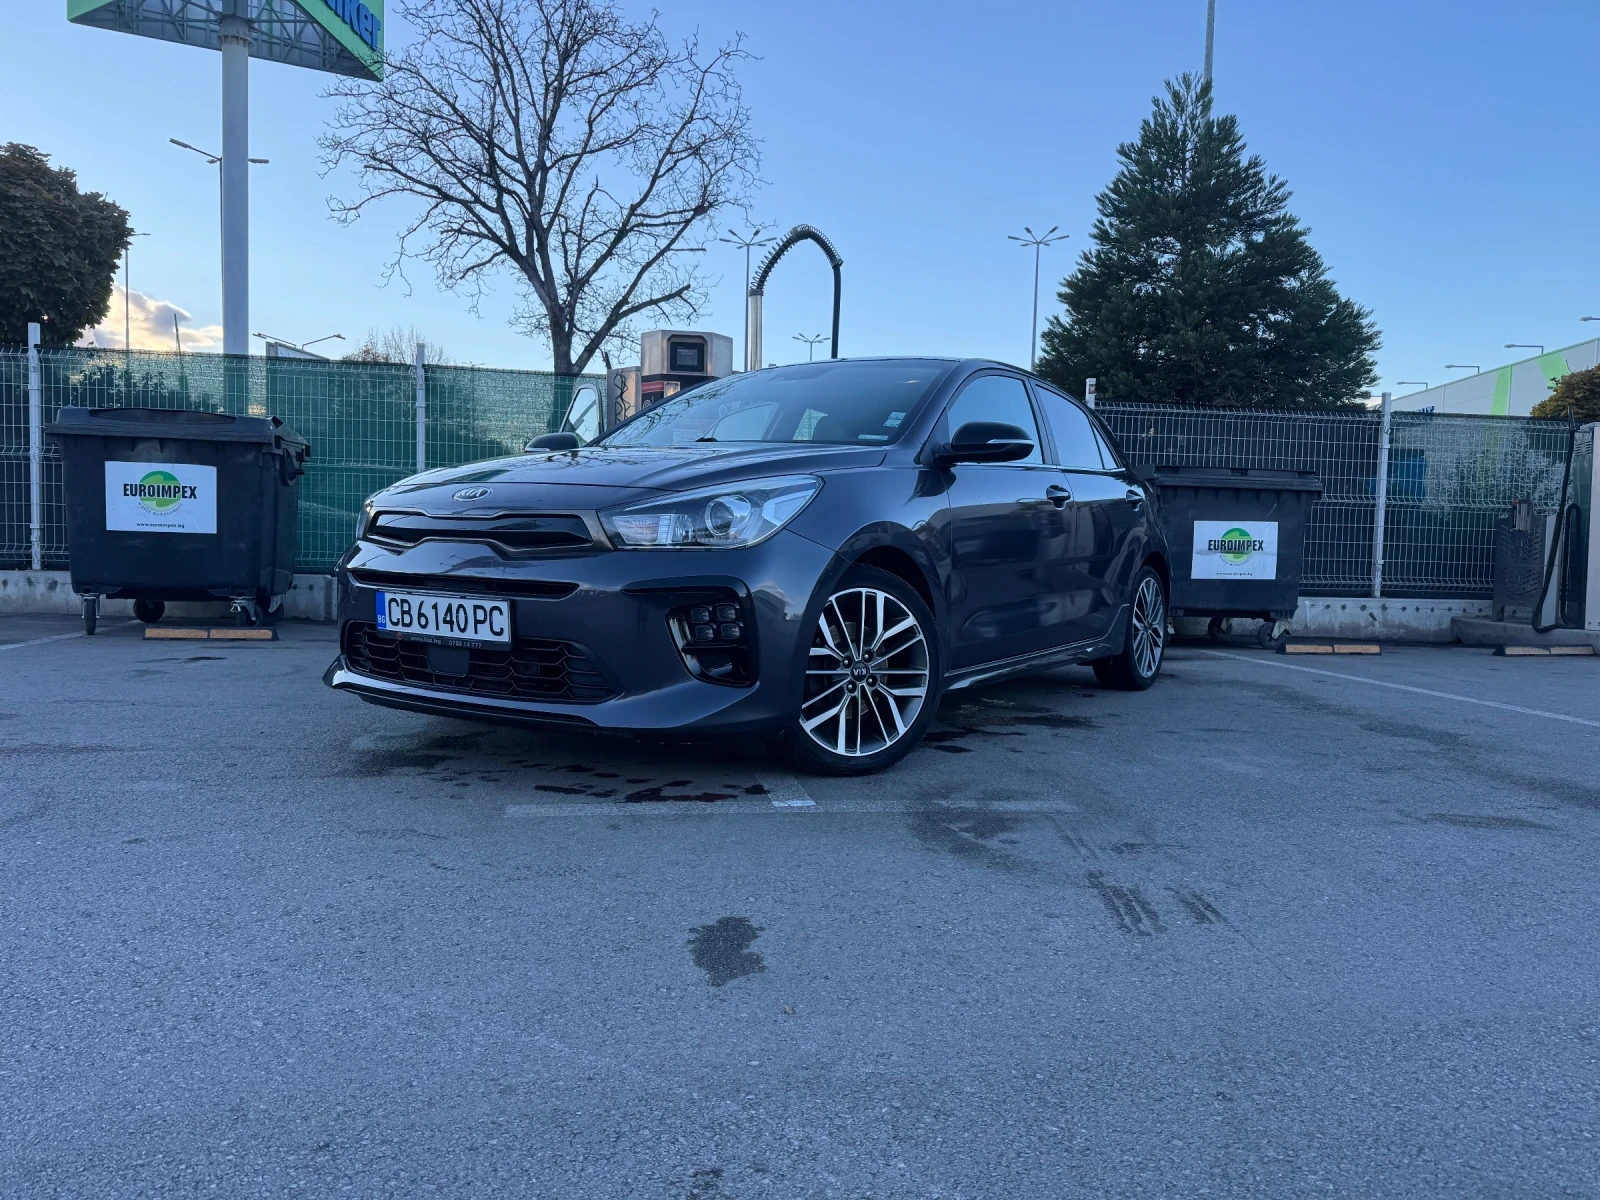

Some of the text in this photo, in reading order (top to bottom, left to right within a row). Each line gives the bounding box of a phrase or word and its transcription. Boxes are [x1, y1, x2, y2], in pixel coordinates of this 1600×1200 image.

[123, 483, 198, 500] EUROIMPEX
[455, 487, 484, 497] KIA
[1207, 539, 1264, 552] EUROIMPEX
[377, 614, 386, 624] BG
[853, 668, 867, 676] KIA
